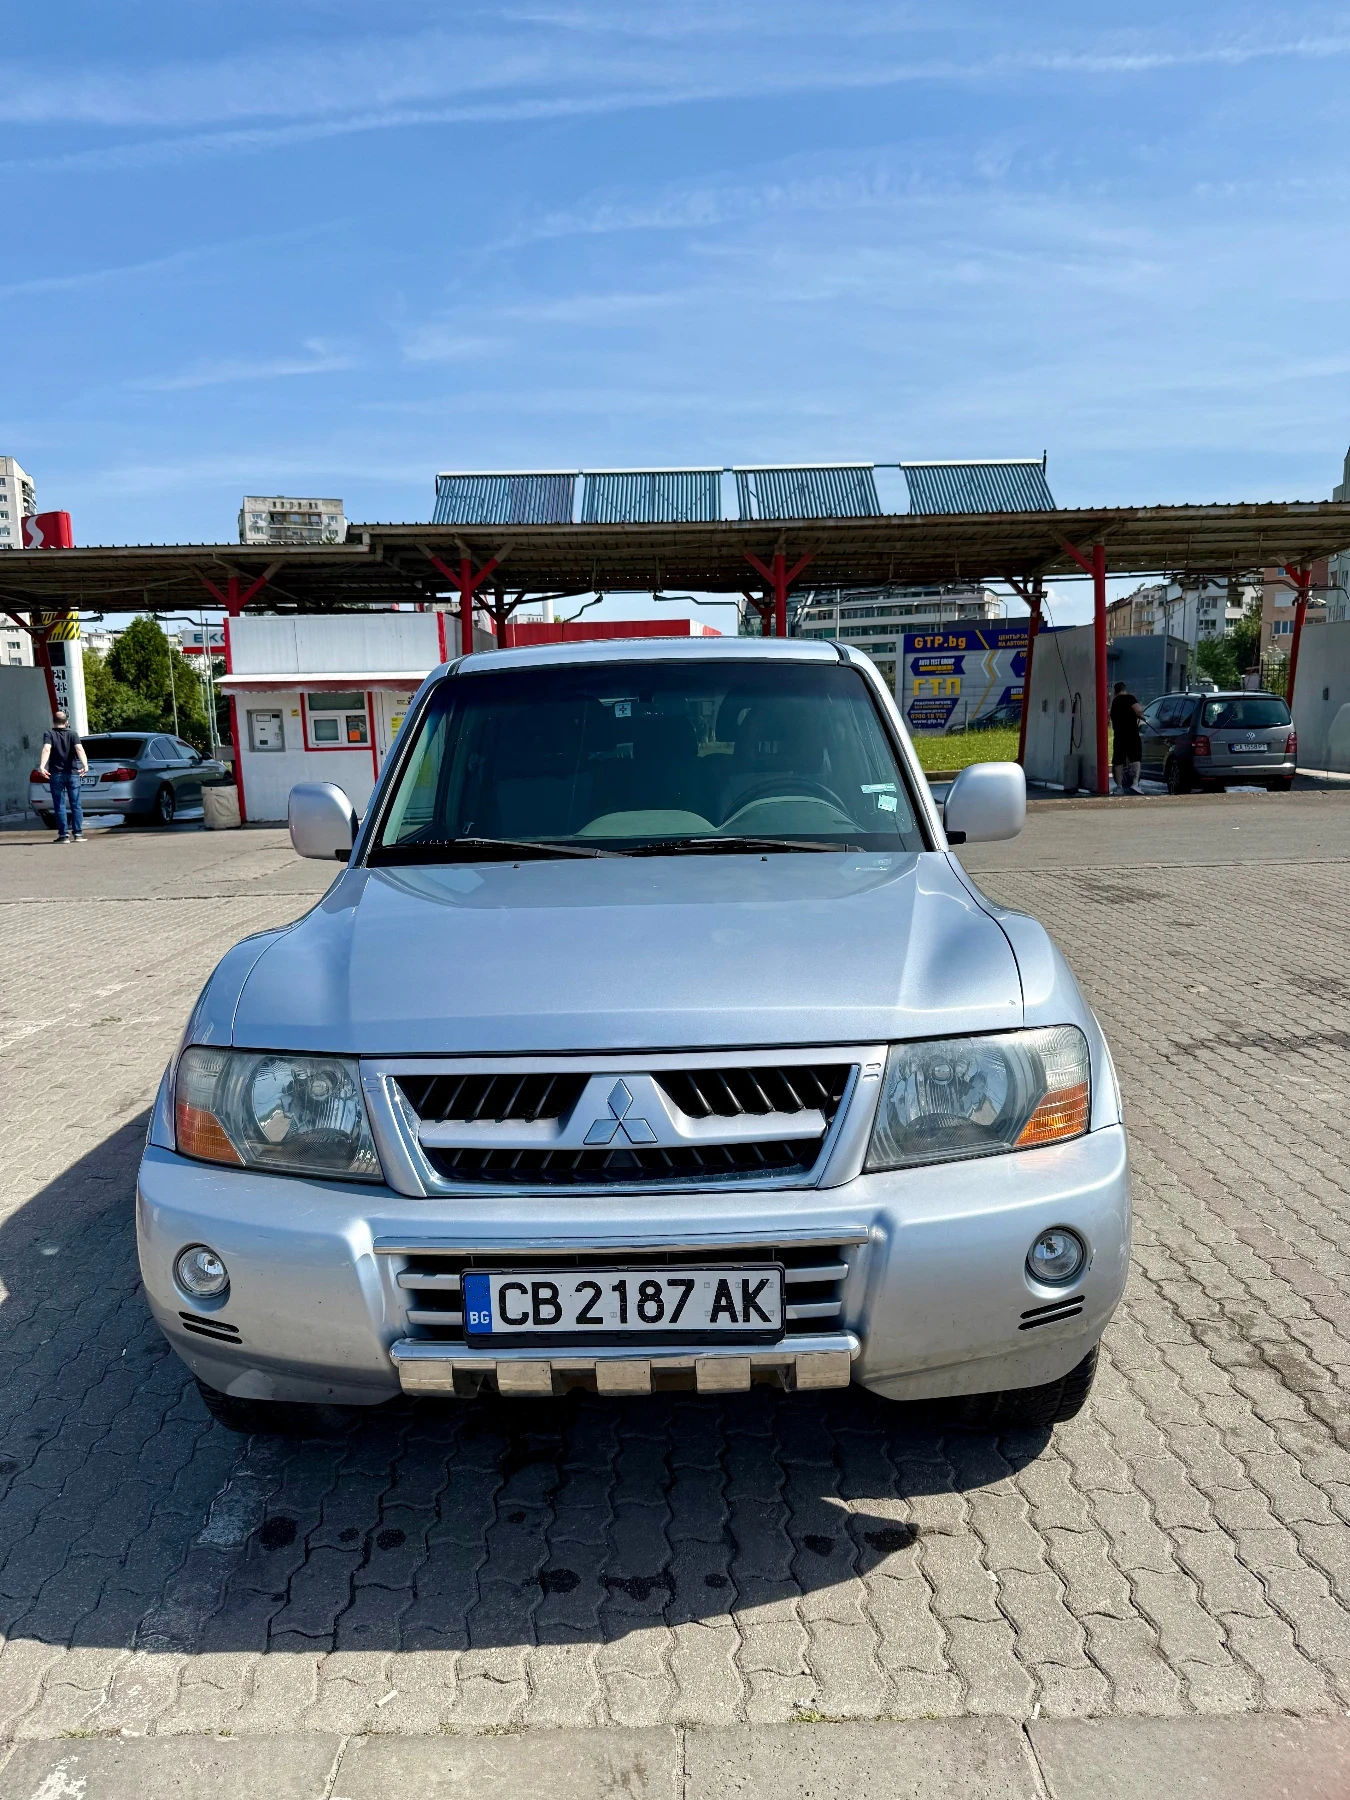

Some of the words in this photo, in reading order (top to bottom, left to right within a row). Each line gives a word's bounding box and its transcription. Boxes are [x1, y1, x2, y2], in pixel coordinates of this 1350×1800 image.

[914, 635, 967, 649] GTP.bg
[998, 633, 1020, 641] ЦЕНТЪР
[913, 677, 961, 696] ГТП
[498, 1281, 563, 1327] CB
[575, 1278, 696, 1325] 2187
[709, 1277, 773, 1324] AK
[469, 1310, 491, 1325] BG
